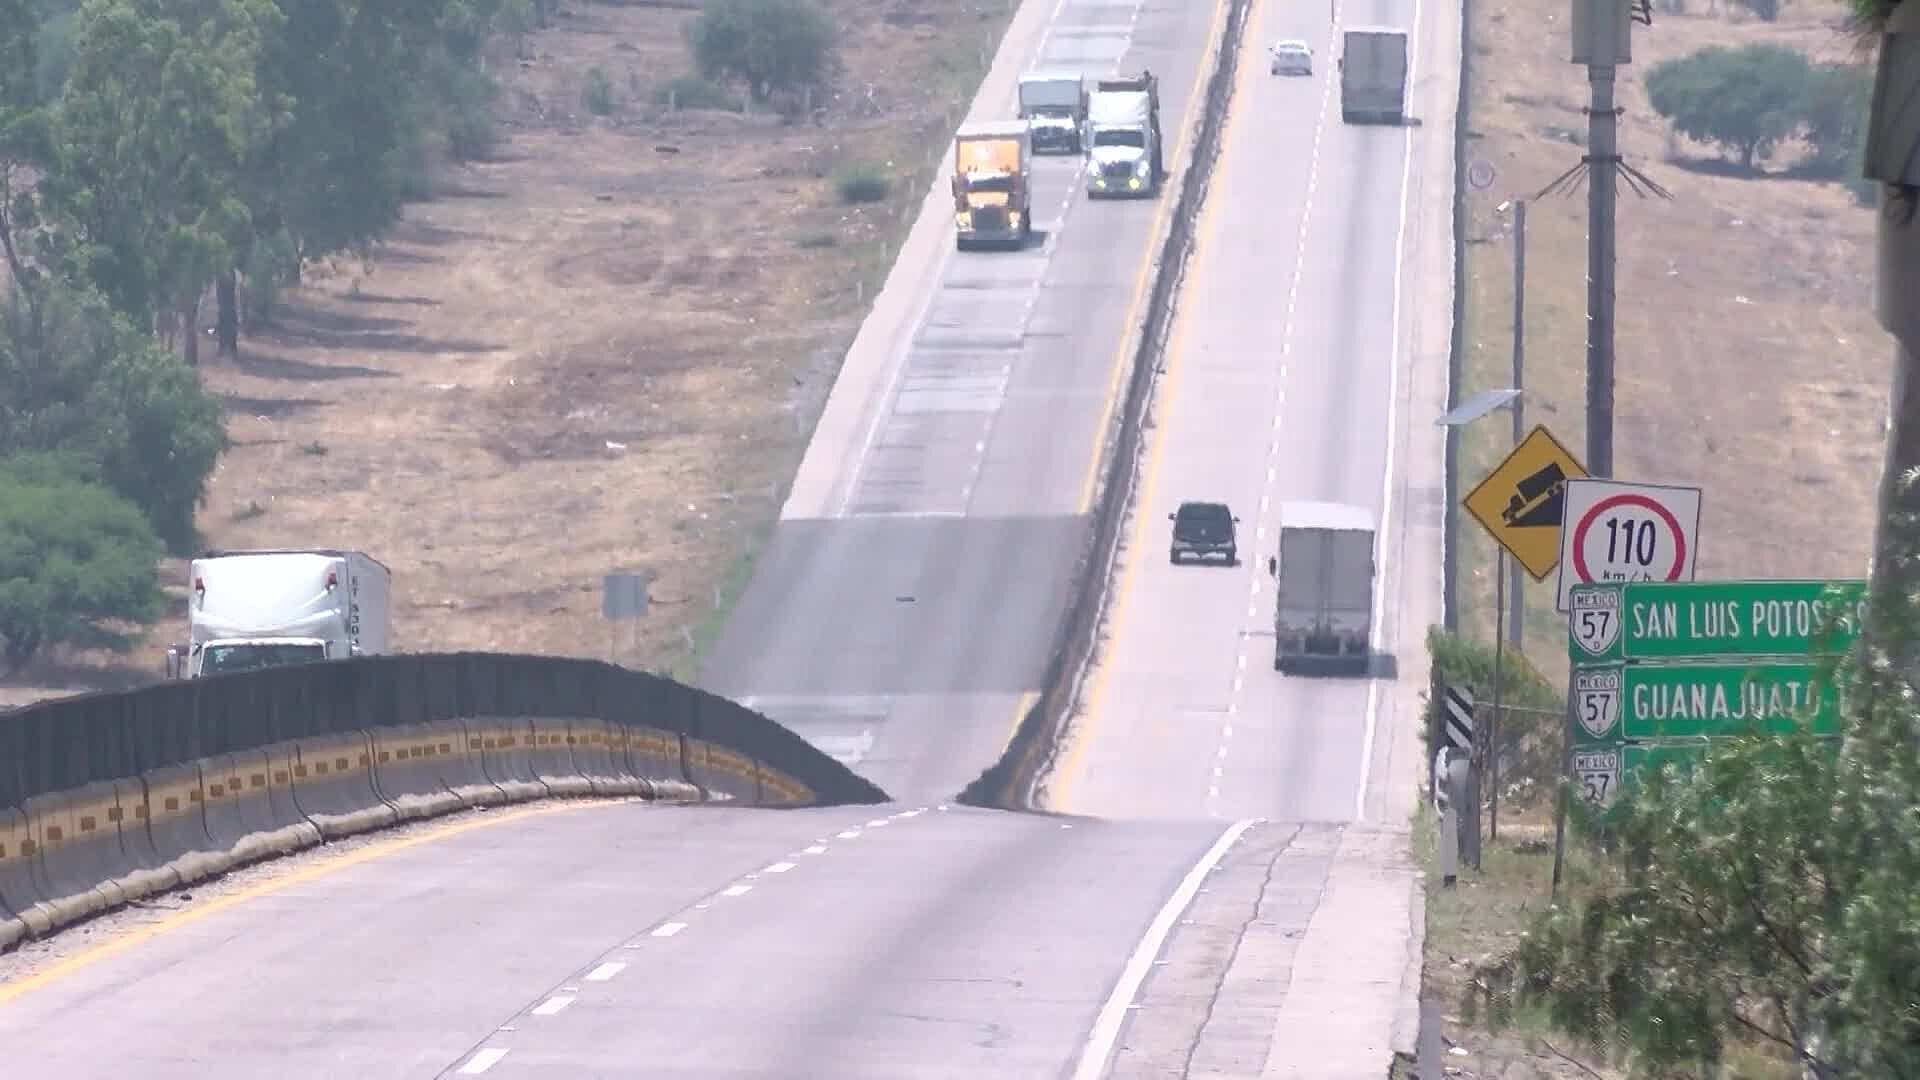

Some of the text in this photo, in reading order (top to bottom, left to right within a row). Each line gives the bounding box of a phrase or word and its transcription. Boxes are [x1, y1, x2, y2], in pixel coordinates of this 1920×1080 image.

[1606, 517, 1656, 566] 110
[1577, 594, 1616, 606] MEXICO
[1582, 611, 1610, 639] 57
[1632, 602, 1678, 638] SAN
[1690, 602, 1741, 638] LUIS
[1752, 600, 1831, 638] POTOS
[1580, 679, 1616, 689] MEXICO
[1586, 694, 1611, 721] 57
[1578, 758, 1615, 768] MEXICO
[1584, 773, 1610, 801] 57
